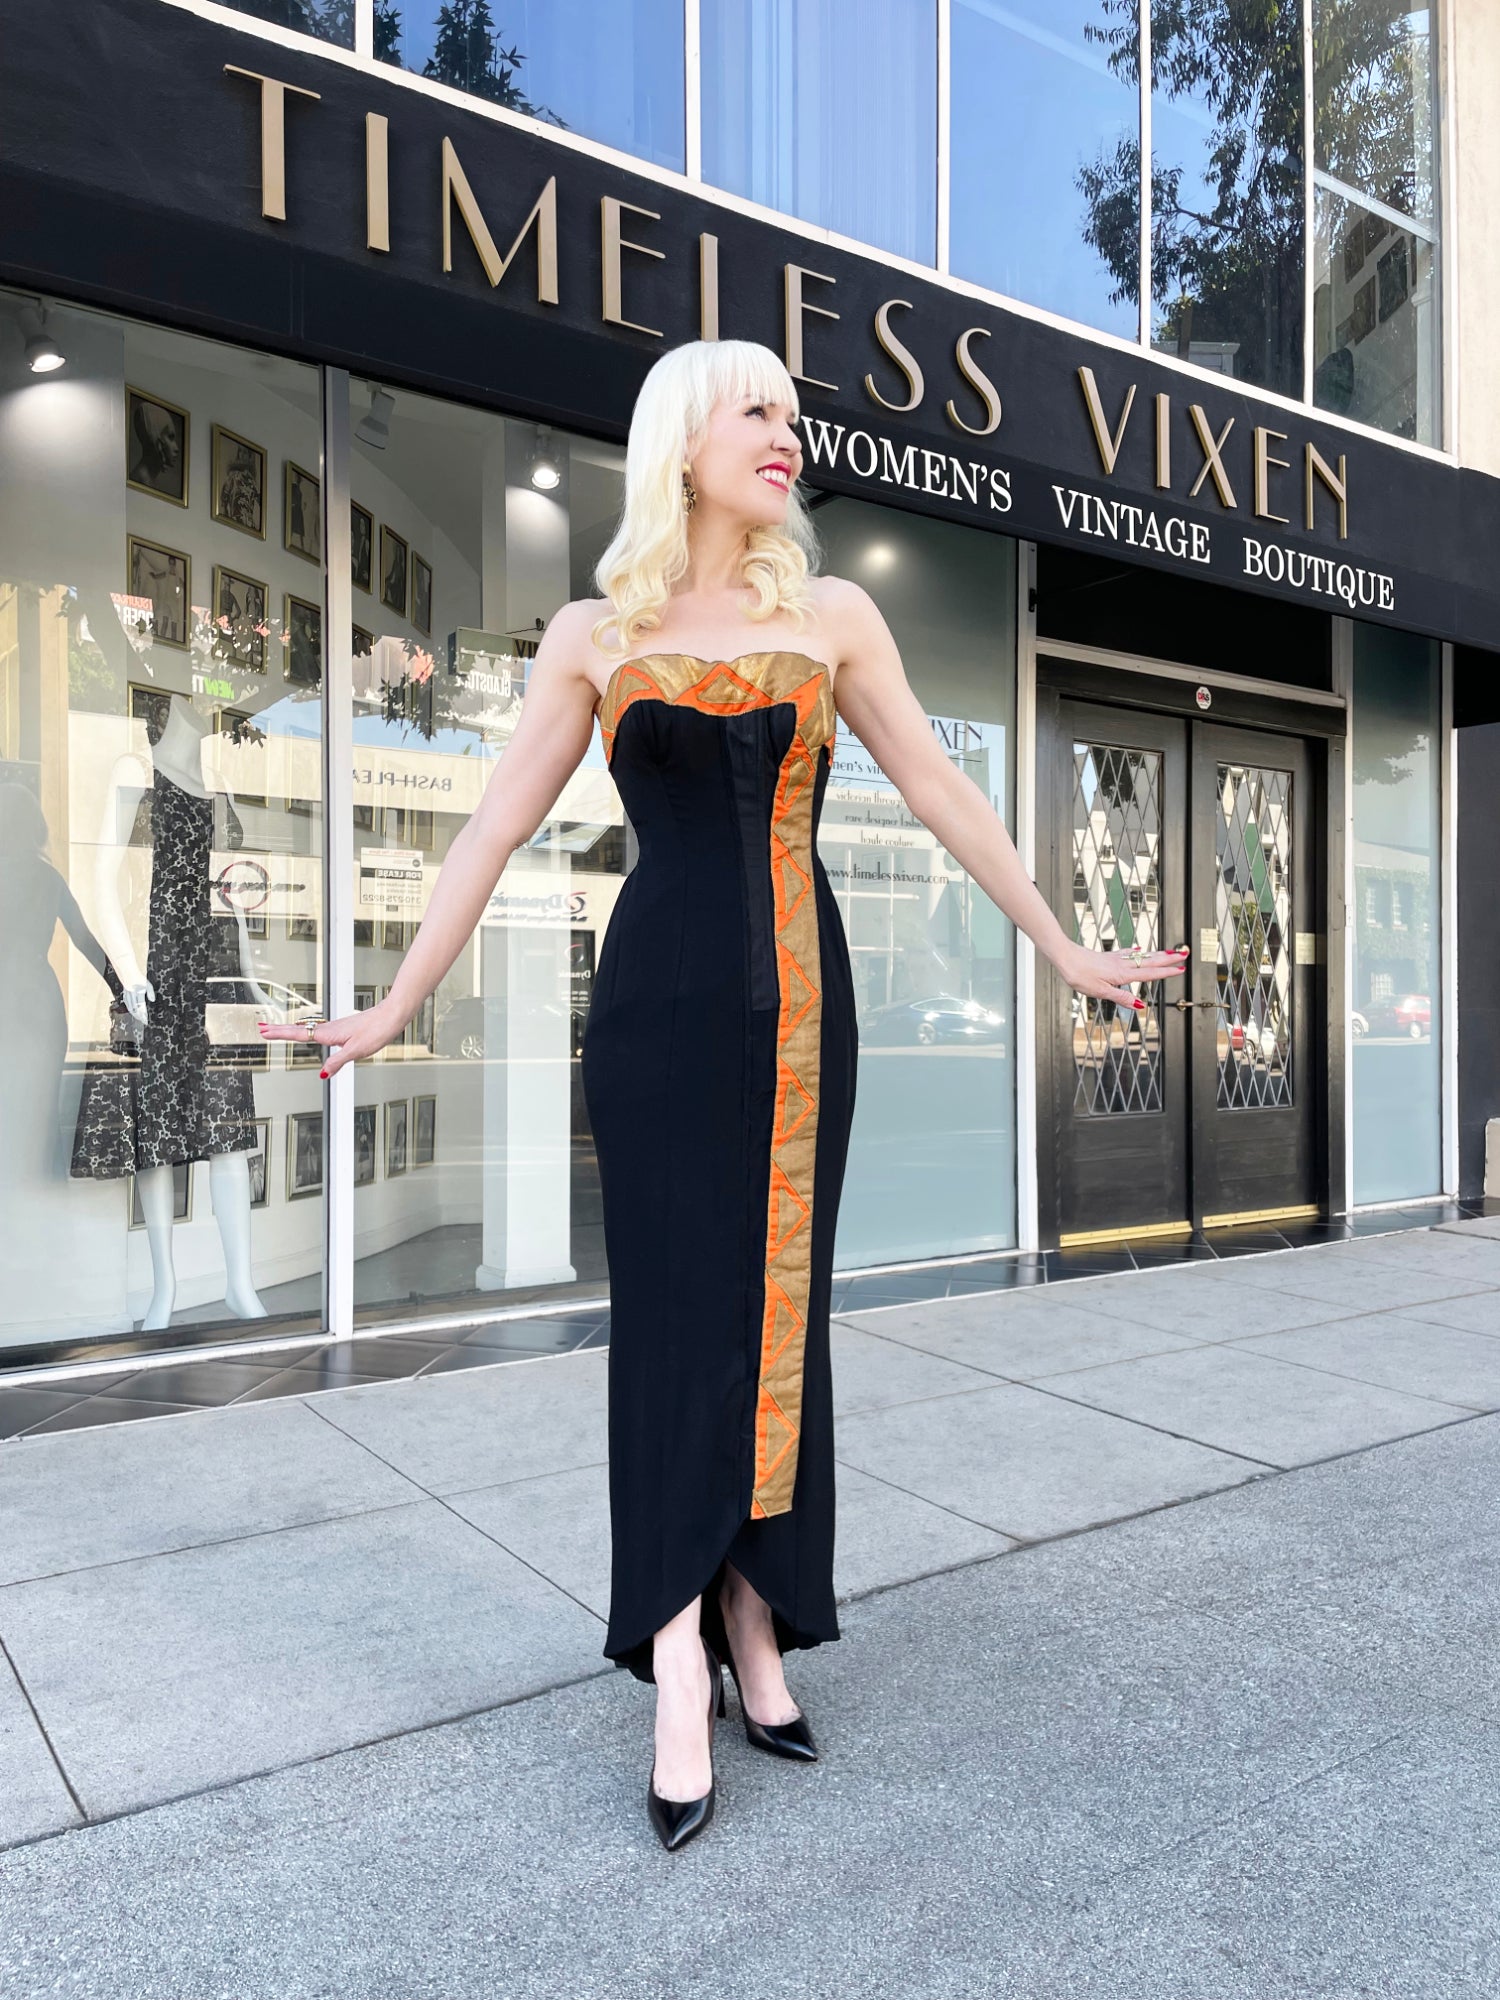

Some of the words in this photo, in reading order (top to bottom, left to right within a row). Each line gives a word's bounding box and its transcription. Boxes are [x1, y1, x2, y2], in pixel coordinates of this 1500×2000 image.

[224, 64, 1002, 436] TIMELESS
[1078, 366, 1347, 539] VIXEN
[800, 415, 1013, 512] WOMEN'S
[1052, 485, 1211, 564] VINTAGE
[1242, 537, 1395, 609] BOUTIQUE
